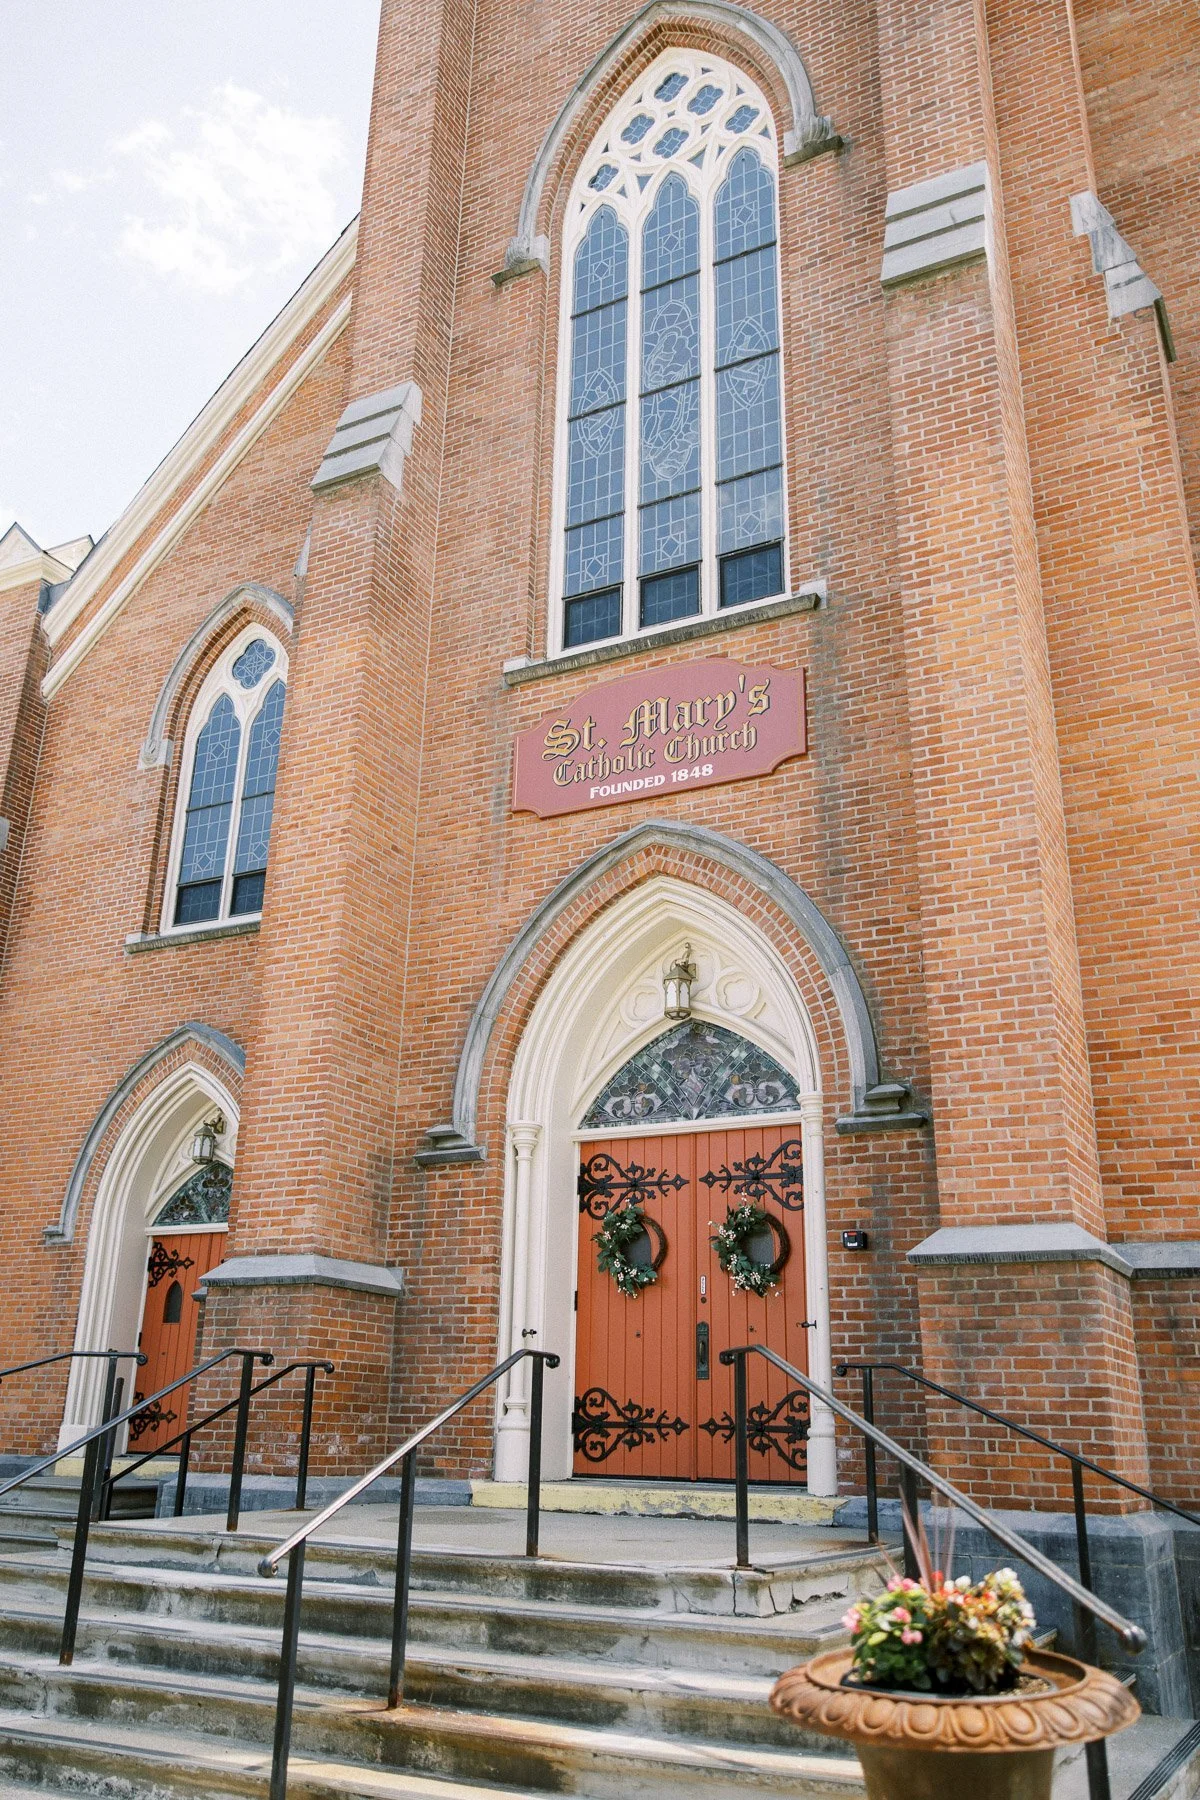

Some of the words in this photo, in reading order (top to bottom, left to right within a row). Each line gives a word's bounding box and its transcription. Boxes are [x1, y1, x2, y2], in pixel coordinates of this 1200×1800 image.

[541, 715, 607, 760] St.
[619, 673, 771, 748] Mary's
[552, 745, 656, 786] Catholic
[663, 720, 757, 764] Church
[589, 774, 666, 799] FOUNDED
[671, 763, 714, 783] 1848
